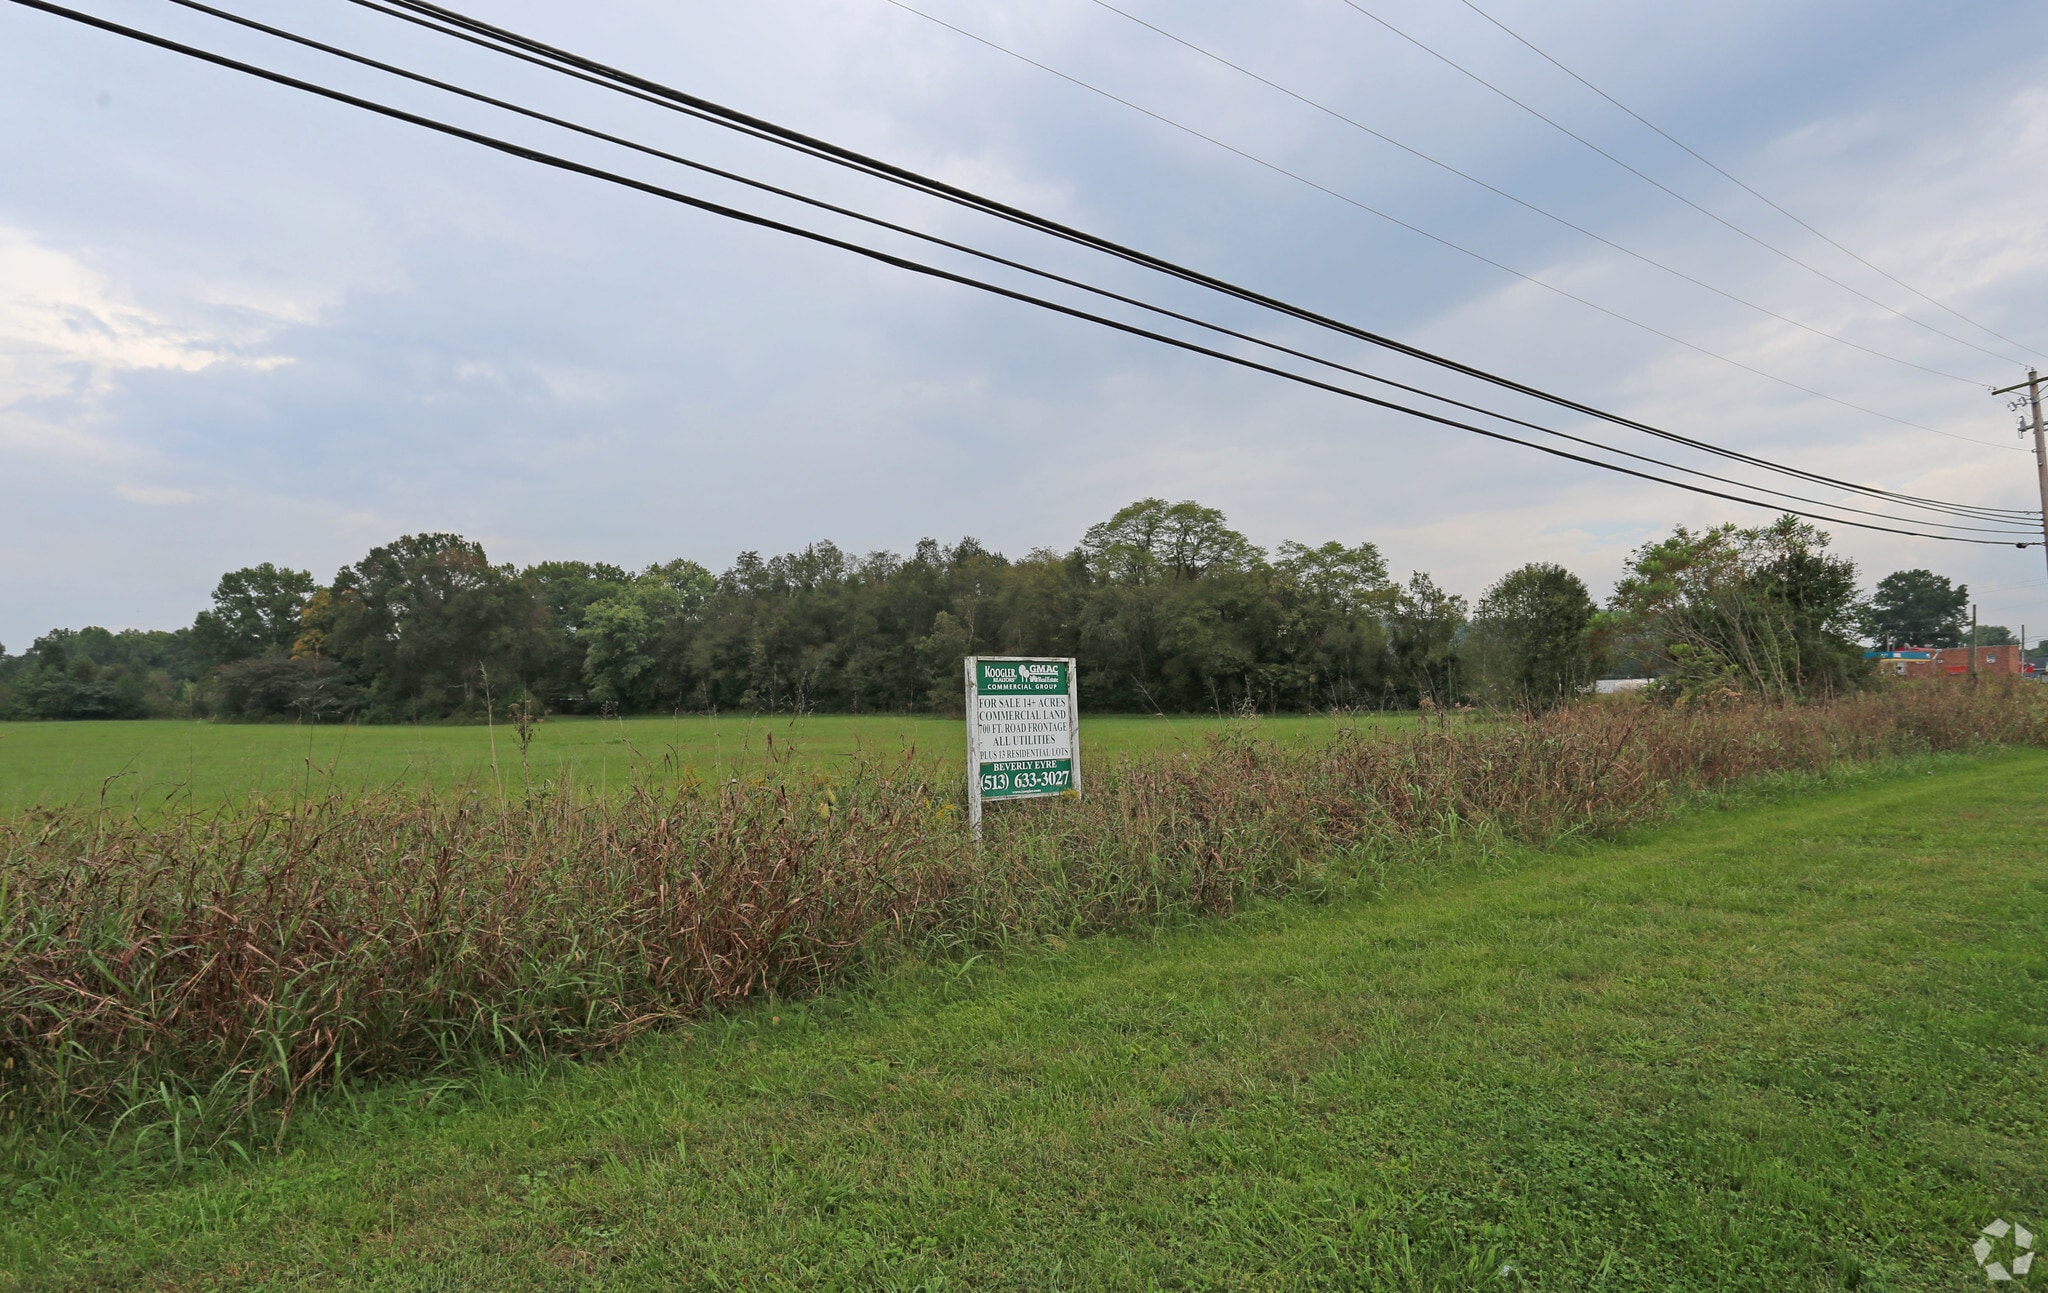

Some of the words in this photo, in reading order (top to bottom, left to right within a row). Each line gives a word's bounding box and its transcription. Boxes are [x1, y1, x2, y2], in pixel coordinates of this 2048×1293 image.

[979, 699, 996, 708] FOR
[999, 698, 1020, 708] SALE
[1024, 698, 1036, 707] 14+
[1038, 698, 1066, 707] ACRES
[979, 710, 1042, 721] COMMERCIAL
[1044, 710, 1066, 720] LAND
[992, 724, 1003, 733] FT.
[1005, 723, 1026, 733] ROAD
[1028, 722, 1067, 732] FRONTAGE
[993, 736, 1010, 746] ALL
[1013, 735, 1056, 745] UTILITIES
[980, 751, 997, 760] PLUS
[1007, 748, 1050, 758] RESIDENTIAL
[1052, 747, 1068, 756] LOTS
[994, 761, 1032, 771] BEVERLY
[1035, 760, 1057, 769] EYRE
[981, 772, 1009, 791] (513)
[1014, 770, 1070, 788] 633-3027
